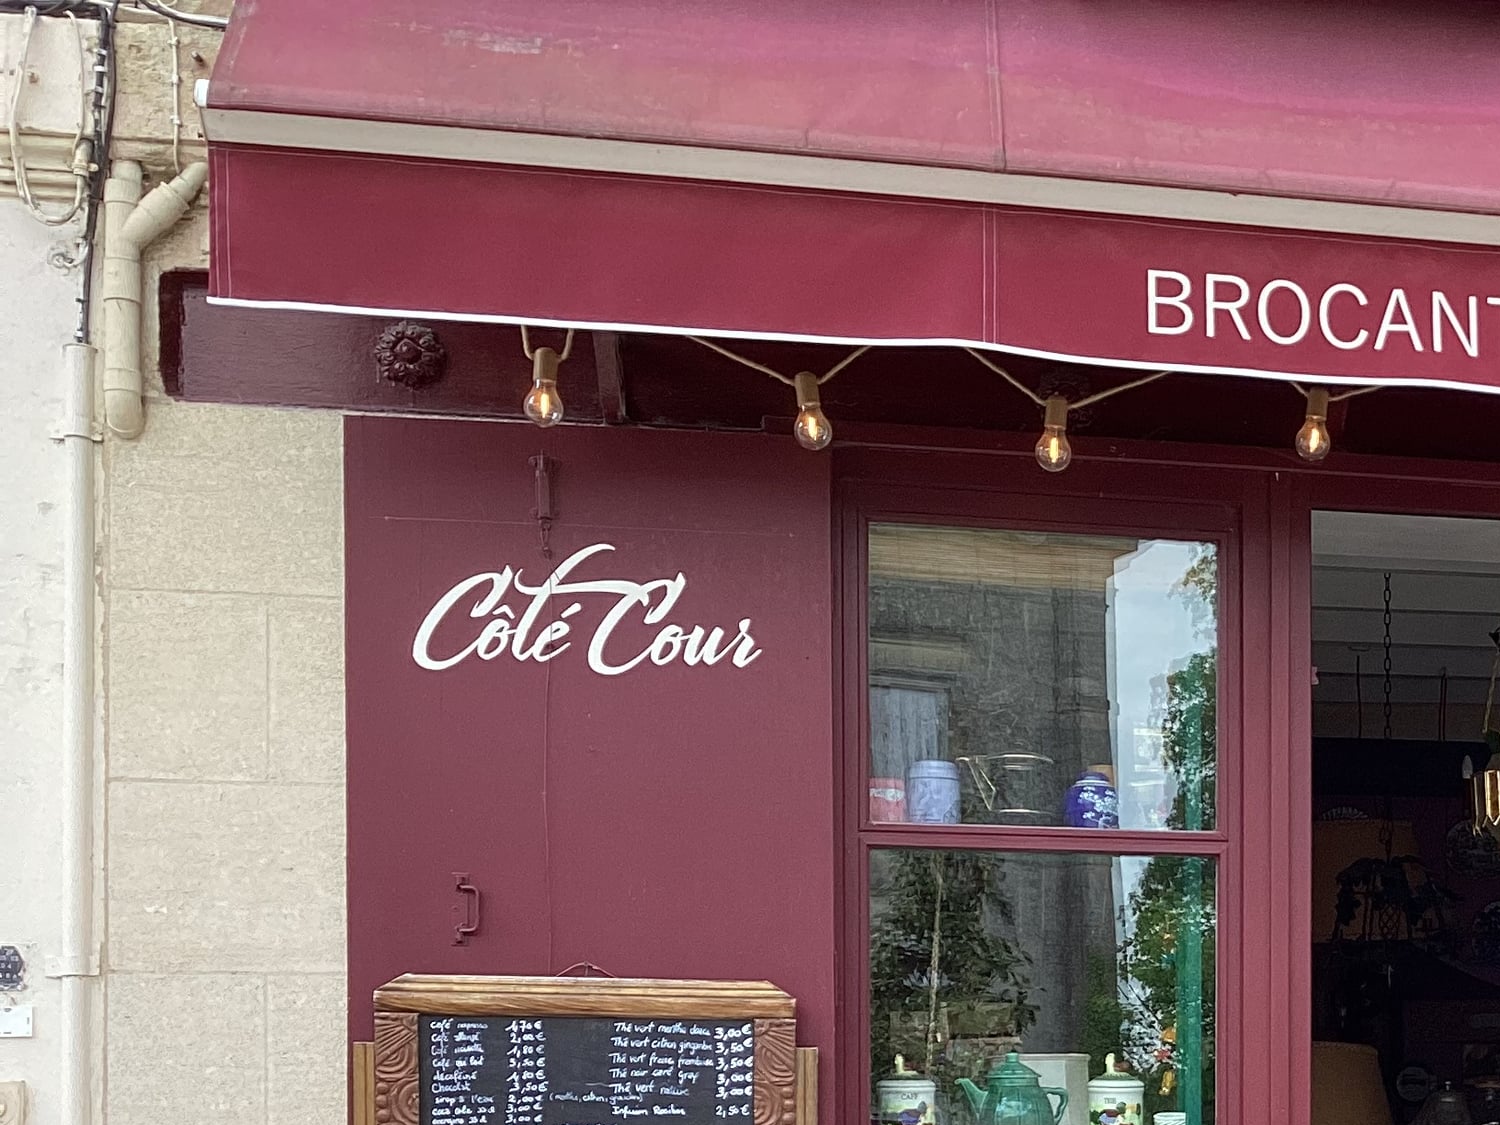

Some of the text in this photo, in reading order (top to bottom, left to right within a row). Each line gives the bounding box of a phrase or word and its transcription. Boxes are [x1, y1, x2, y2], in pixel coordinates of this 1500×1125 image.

[412, 543, 763, 675] Côté Cour
[614, 1022, 631, 1033] Thé
[610, 1036, 628, 1048] Thé
[608, 1053, 626, 1064] Thé
[609, 1068, 627, 1079] Thé
[609, 1082, 632, 1094] Thé
